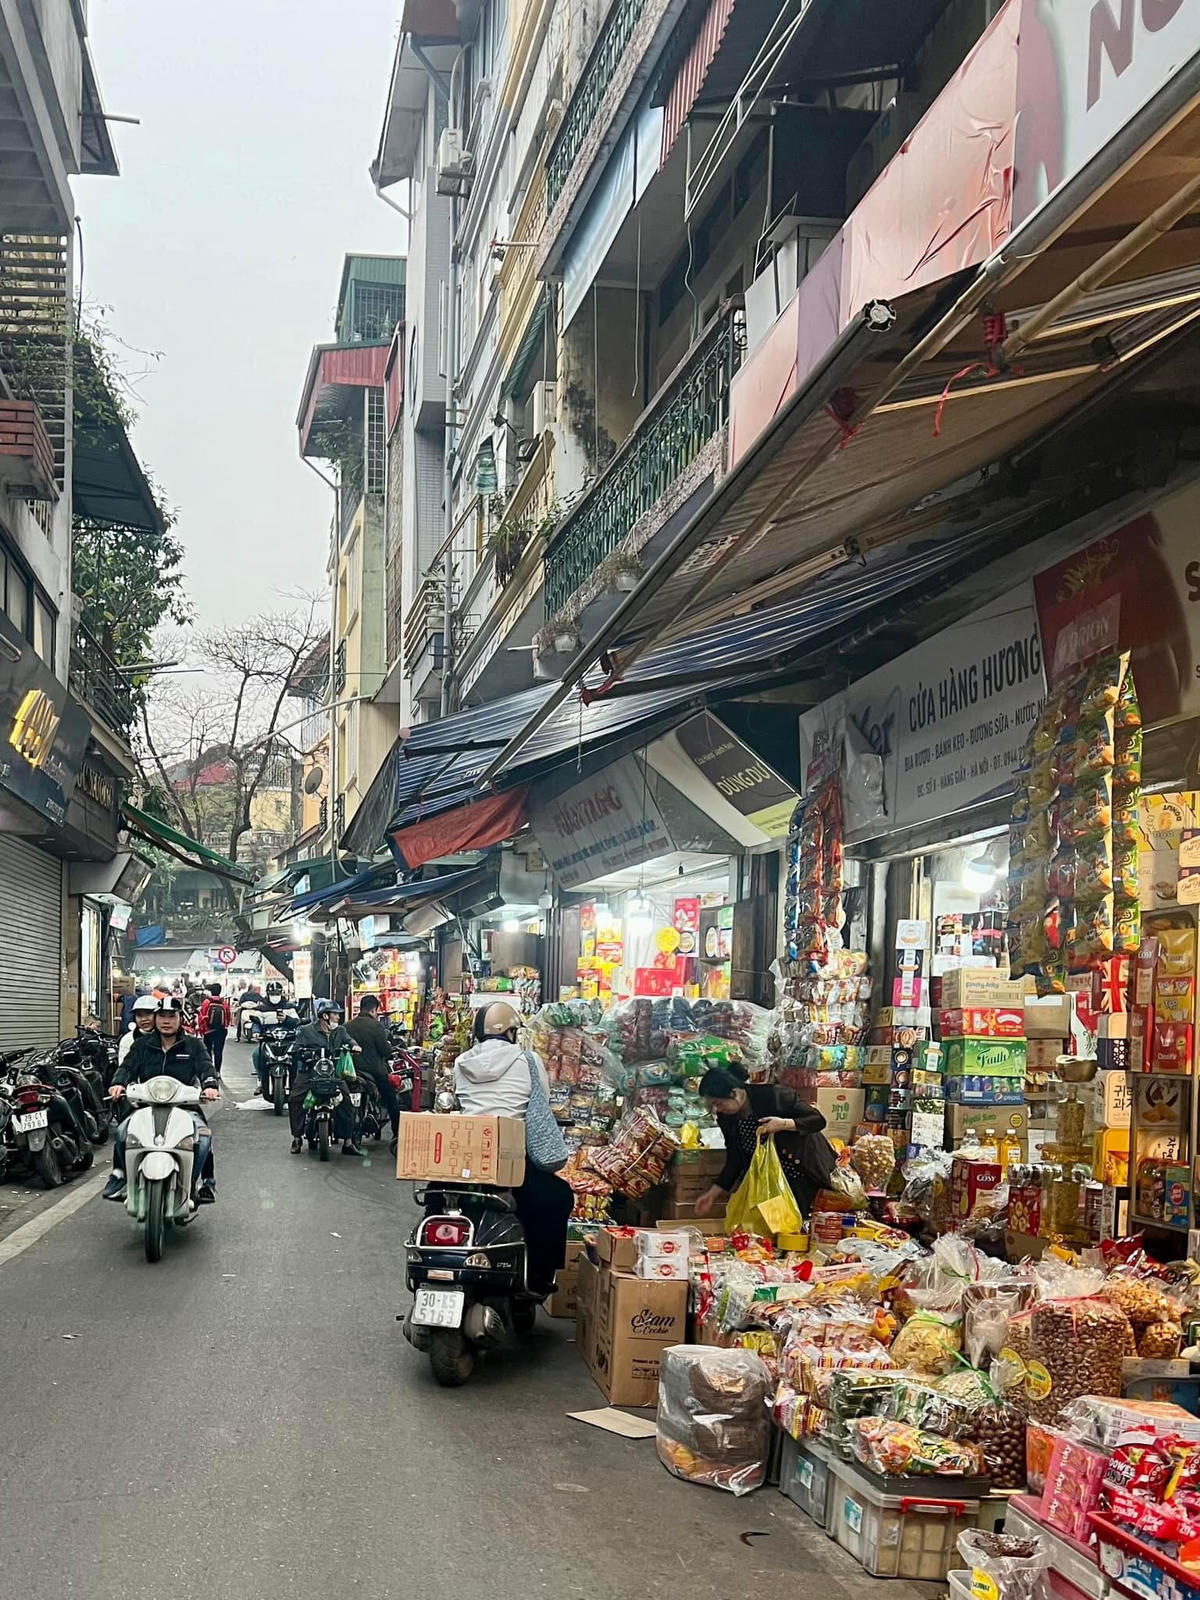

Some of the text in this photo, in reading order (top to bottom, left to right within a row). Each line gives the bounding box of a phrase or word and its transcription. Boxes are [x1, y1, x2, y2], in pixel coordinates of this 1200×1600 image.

[939, 668, 978, 719] HÀNG
[976, 1173, 996, 1182] COSY
[631, 1308, 675, 1328] Siam
[641, 1325, 669, 1335] Cookie
